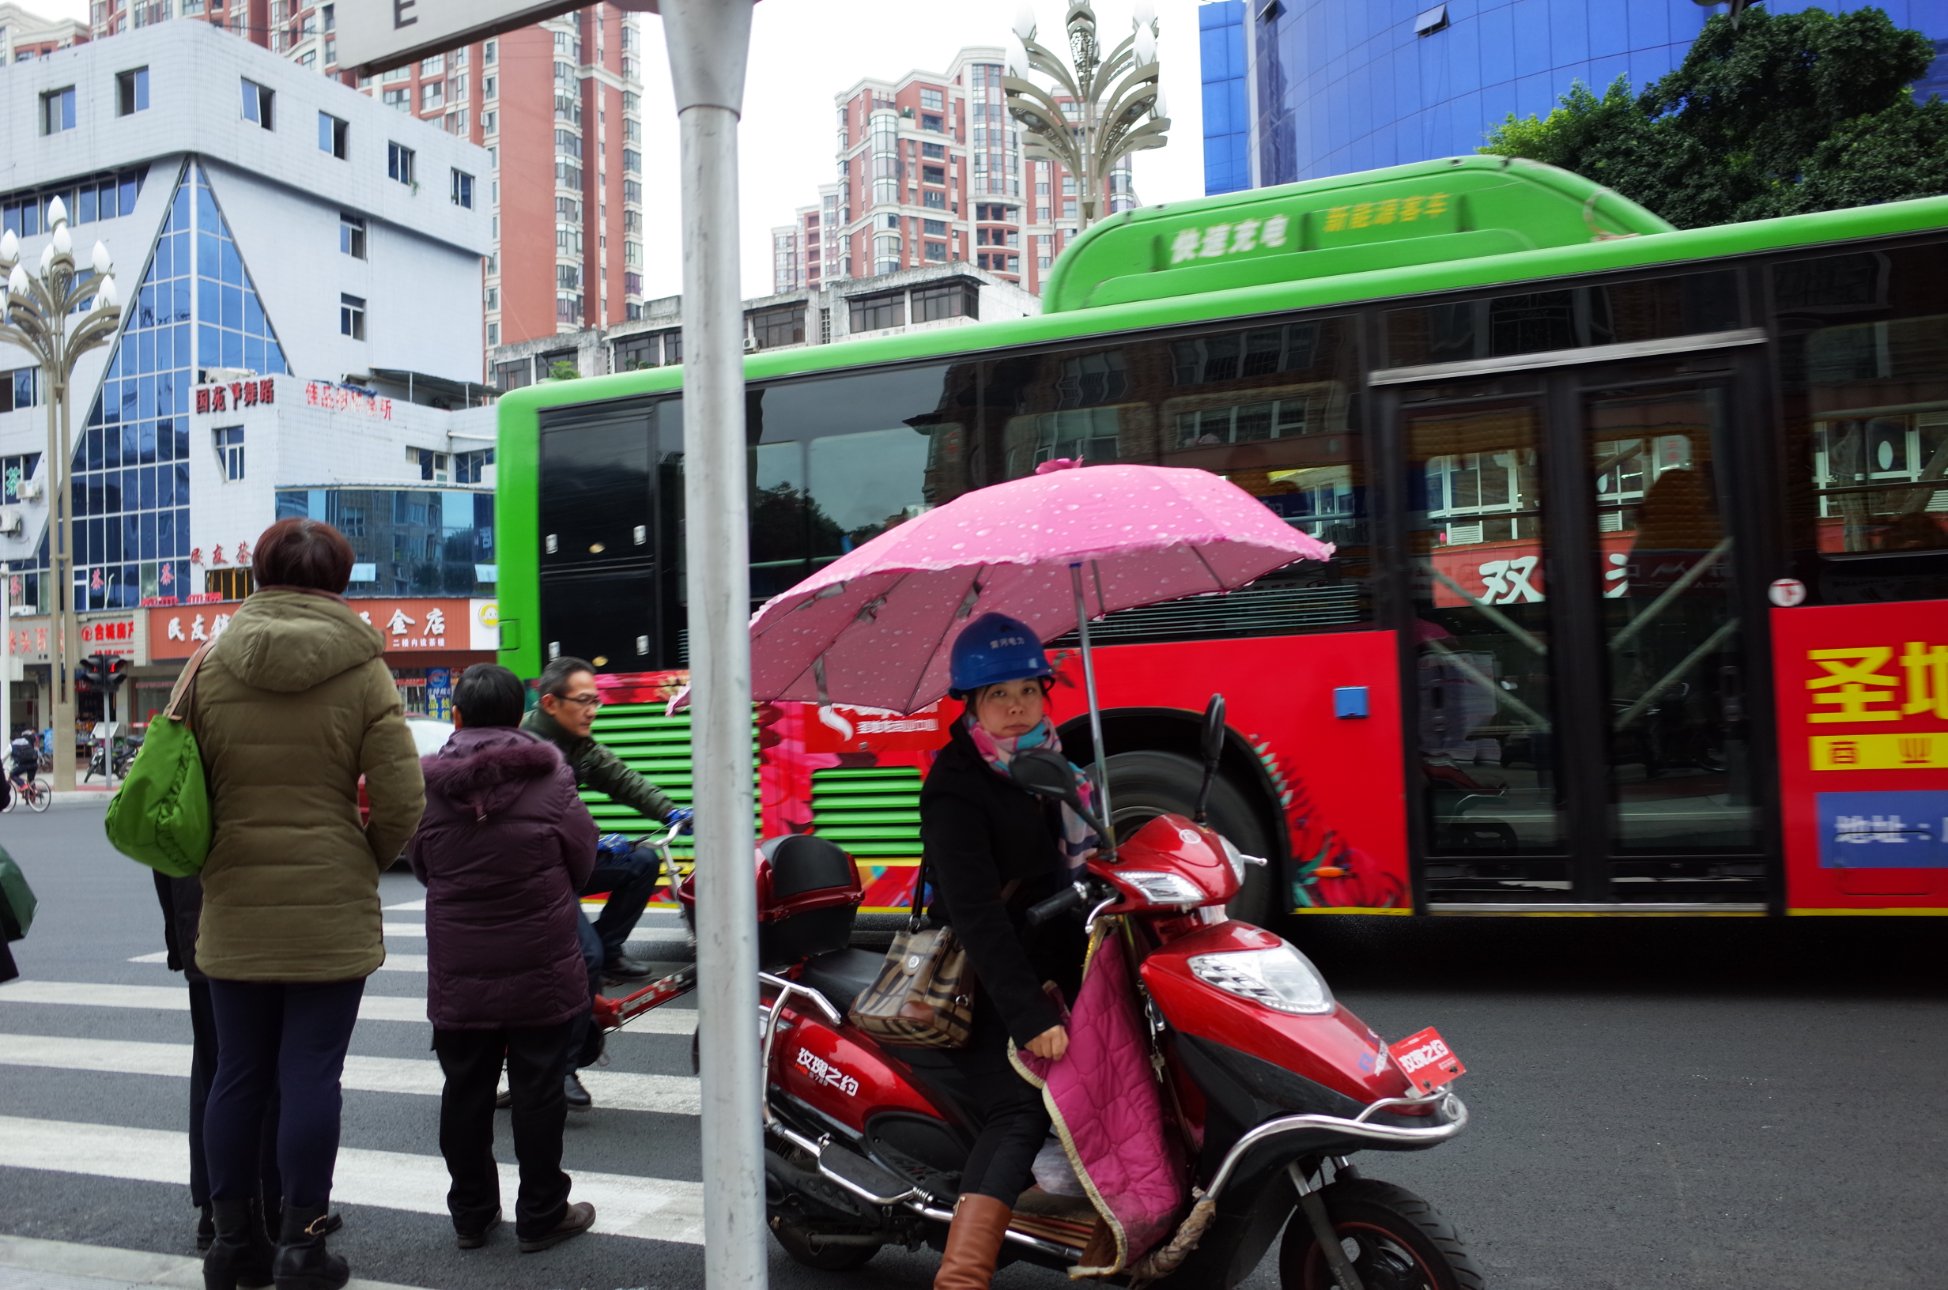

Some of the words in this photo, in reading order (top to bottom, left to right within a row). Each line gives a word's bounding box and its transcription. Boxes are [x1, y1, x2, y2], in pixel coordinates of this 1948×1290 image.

[1323, 192, 1450, 234] 新能源客车
[1170, 214, 1290, 265] 快速充电
[796, 1047, 859, 1096] 玫瑰之约
